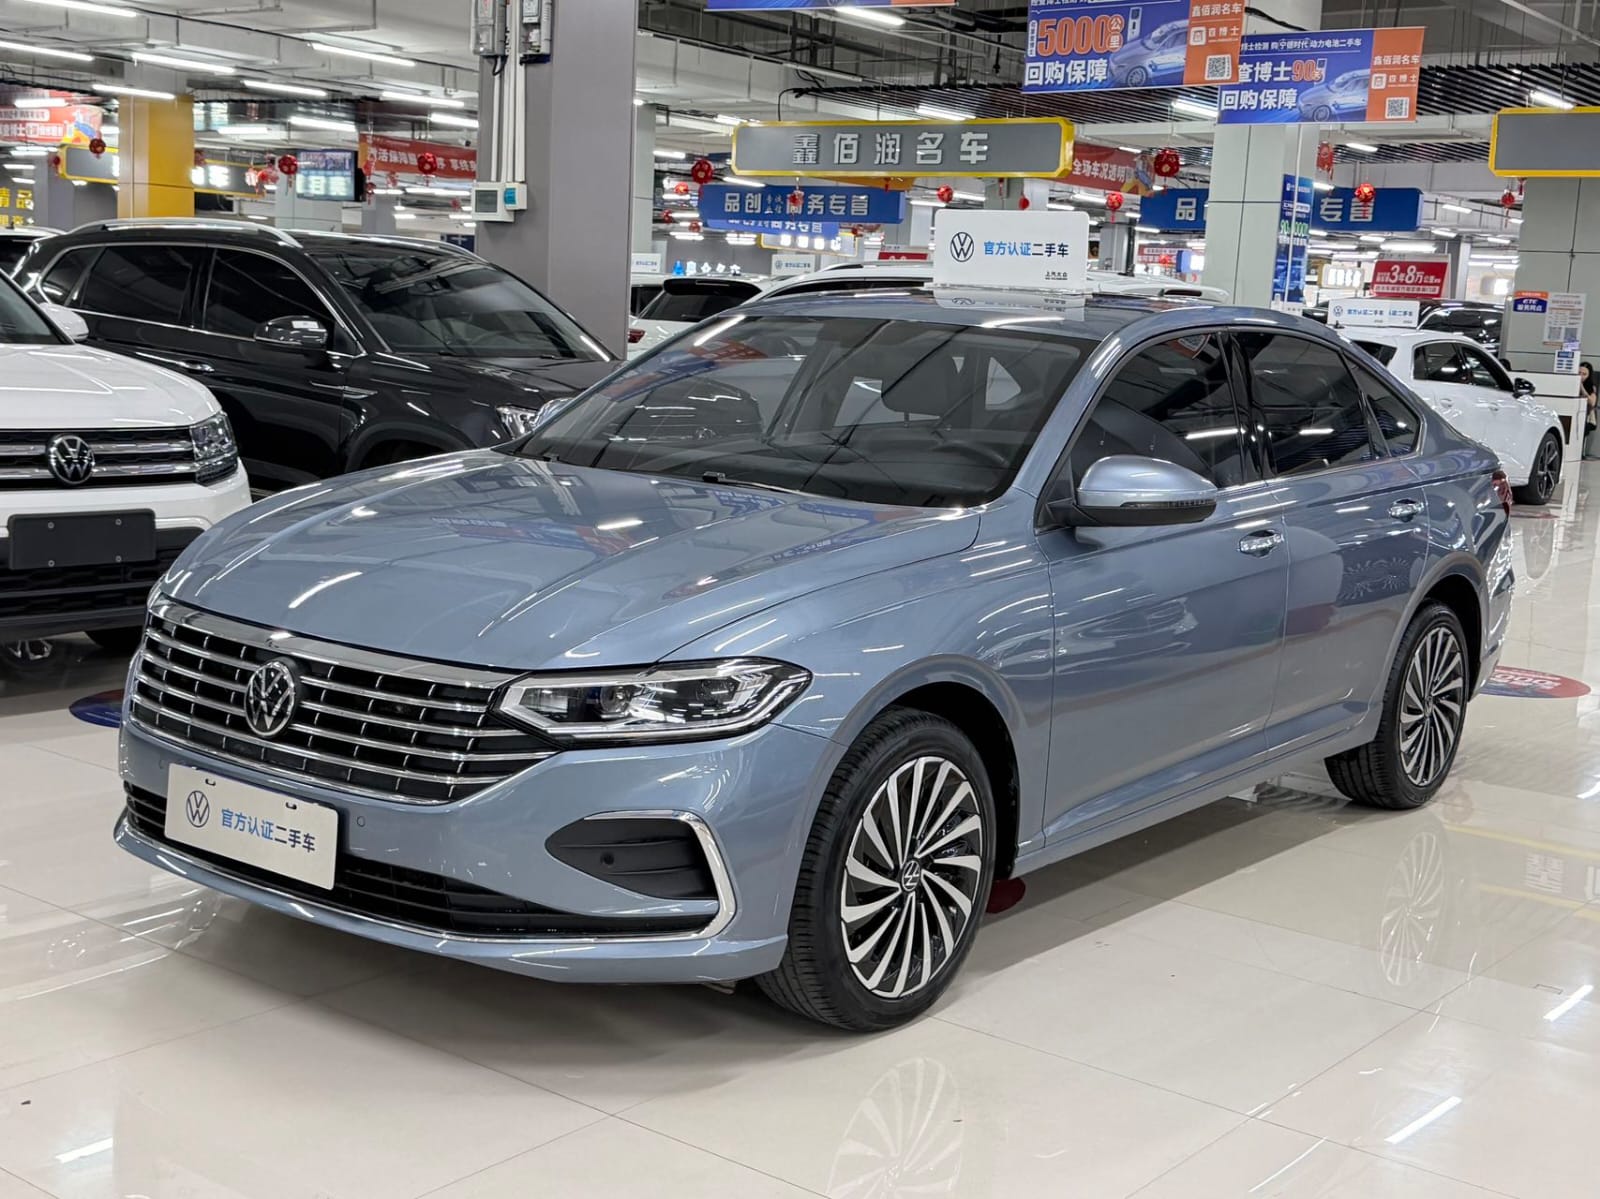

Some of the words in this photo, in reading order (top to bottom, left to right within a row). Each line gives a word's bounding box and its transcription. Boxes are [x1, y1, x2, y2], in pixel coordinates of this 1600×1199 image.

[1192, 3, 1242, 17] 鑫佰润名车
[1373, 55, 1420, 66] 鑫佰润名车
[1025, 59, 1108, 86] 回购保障
[1221, 88, 1298, 111] 回购保障
[792, 131, 990, 166] 鑫佰润名车
[724, 193, 762, 213] 品创
[1175, 197, 1197, 221] 品
[984, 241, 1069, 257] 官方认证二手车
[221, 808, 315, 853] 官方认证二手车
